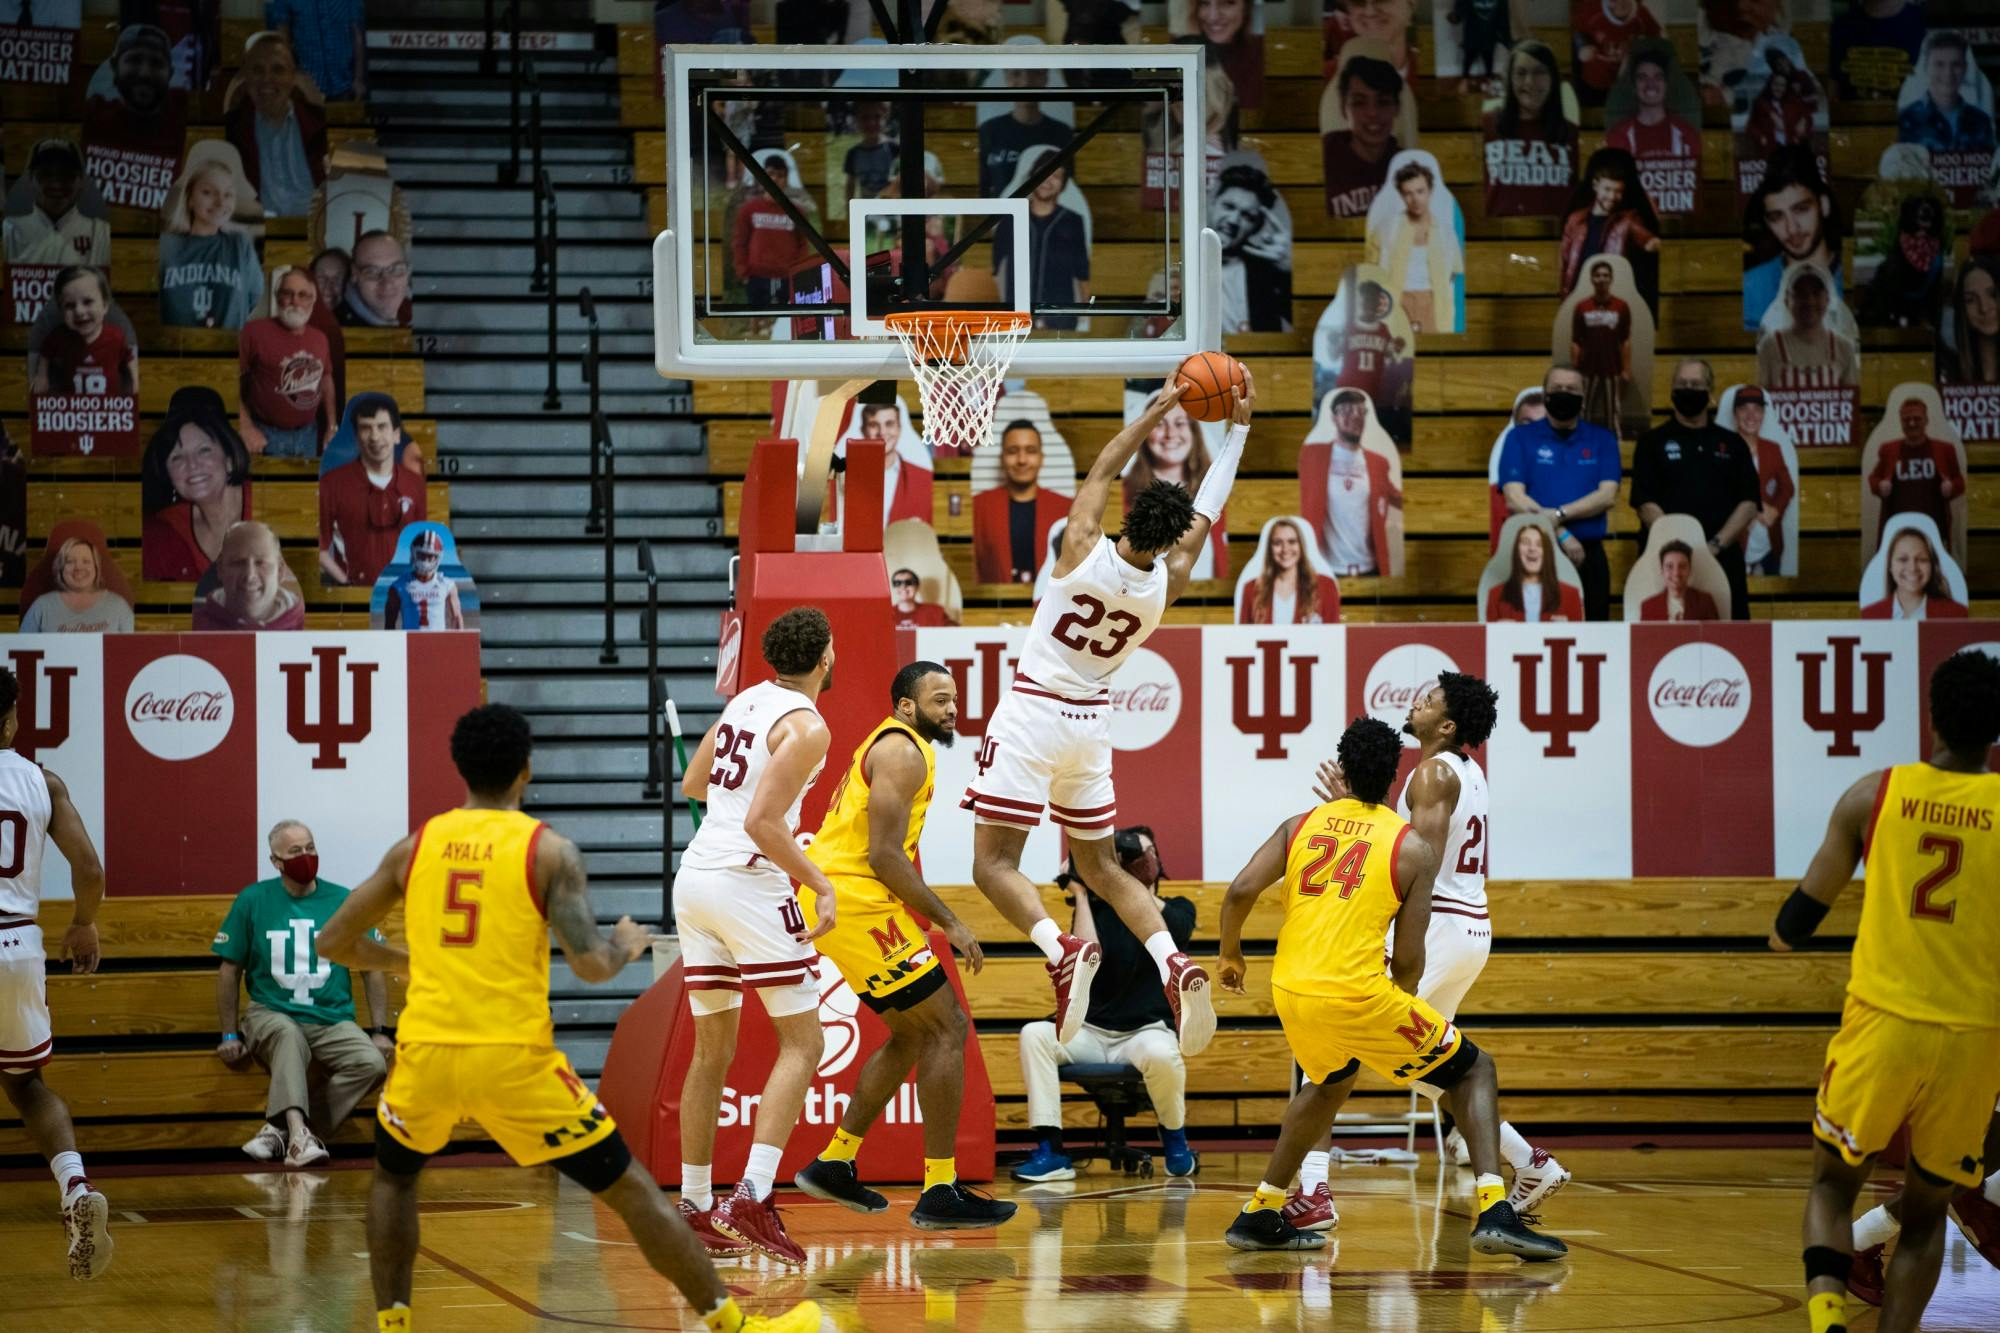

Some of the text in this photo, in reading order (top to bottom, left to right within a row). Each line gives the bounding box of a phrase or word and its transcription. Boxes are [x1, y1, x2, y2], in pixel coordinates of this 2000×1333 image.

[388, 32, 448, 48] WATCH
[121, 150, 161, 166] MEMBER
[1485, 139, 1571, 165] BEAT
[86, 157, 173, 189] HOOSIER
[11, 268, 45, 279] PROUD
[163, 263, 242, 289] INDIANA
[414, 337, 437, 353] 12
[36, 396, 134, 410] HOO HOO HOO
[668, 397, 689, 414] 11
[1799, 390, 1839, 401] MEMBER
[37, 412, 135, 432] HOOSIERS
[437, 459, 460, 475] 10
[1895, 458, 1936, 480] LEO
[706, 519, 718, 536] 9
[1051, 594, 1142, 659] 23
[709, 723, 755, 791] 25
[1902, 797, 1994, 831] WIGGINS
[1324, 816, 1375, 837] SCOTT
[441, 841, 494, 862] AYALA
[1298, 834, 1372, 900] 24
[1910, 831, 1964, 924] 2
[440, 868, 484, 948] 5
